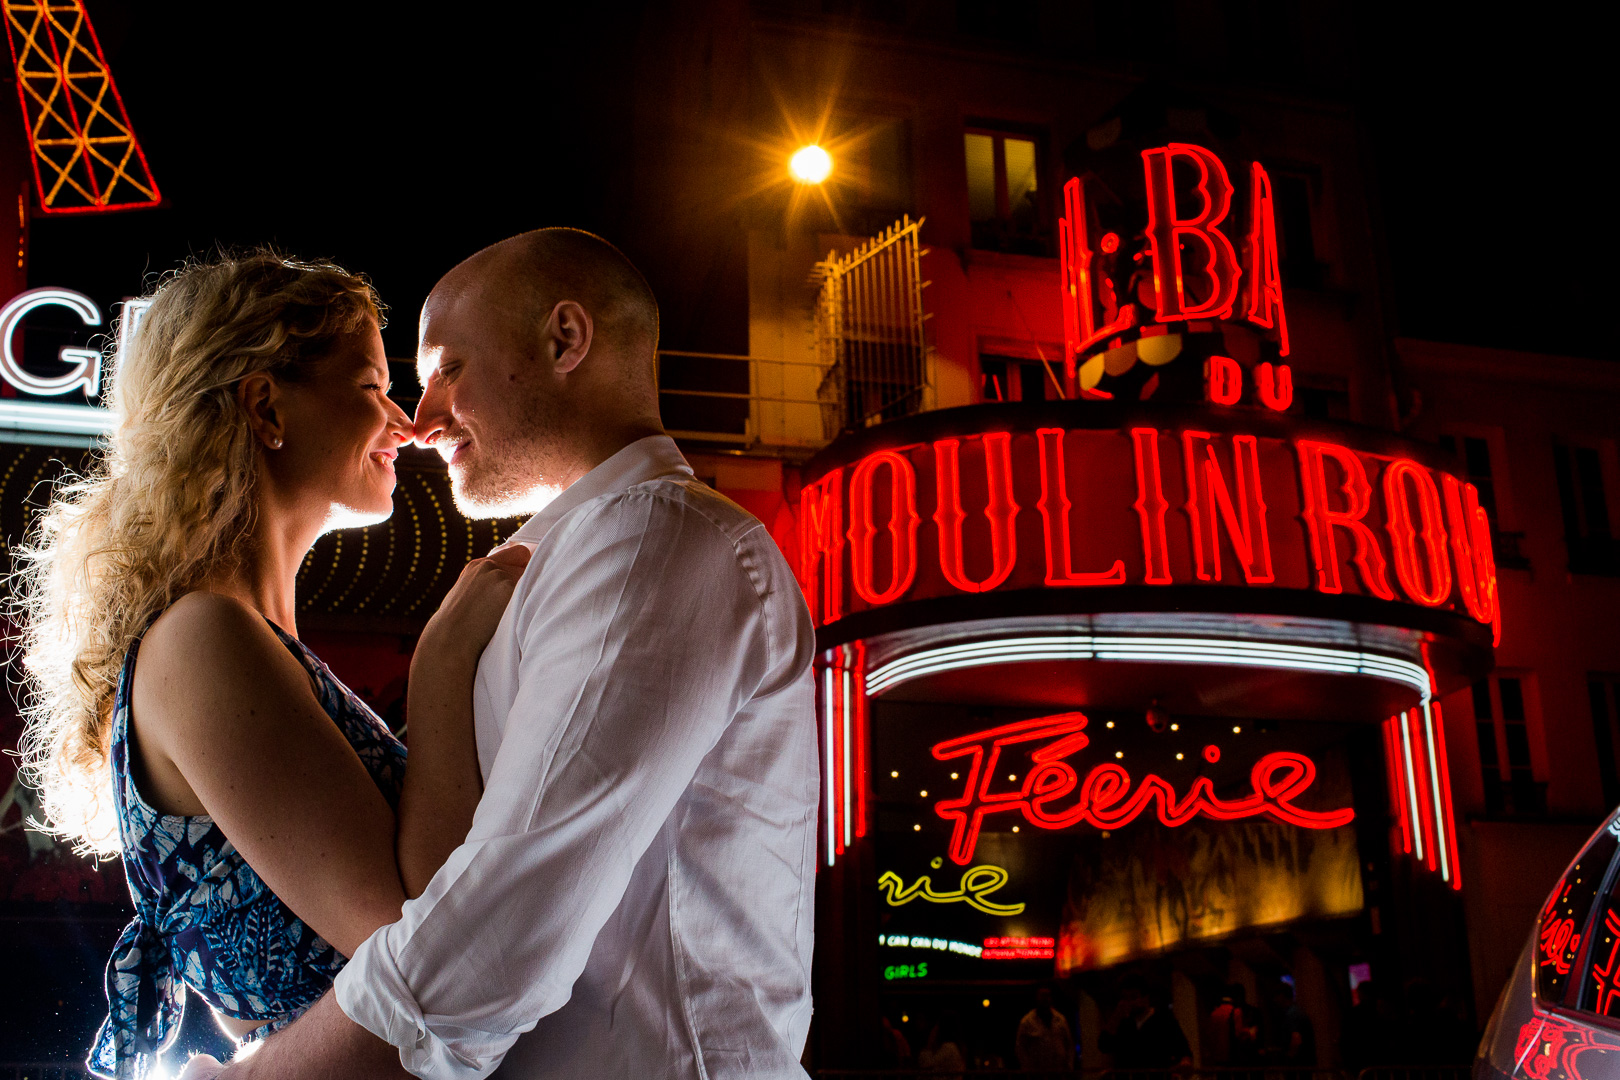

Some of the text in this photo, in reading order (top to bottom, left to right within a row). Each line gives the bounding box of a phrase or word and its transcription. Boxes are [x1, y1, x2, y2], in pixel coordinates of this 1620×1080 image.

[1210, 355, 1294, 412] DU
[800, 426, 1502, 648] MOULIN ROU
[931, 712, 1355, 866] Féerie
[884, 962, 928, 981] GIRLS
[887, 935, 910, 946] CAN
[910, 937, 932, 948] CAN
[932, 938, 948, 951] DU
